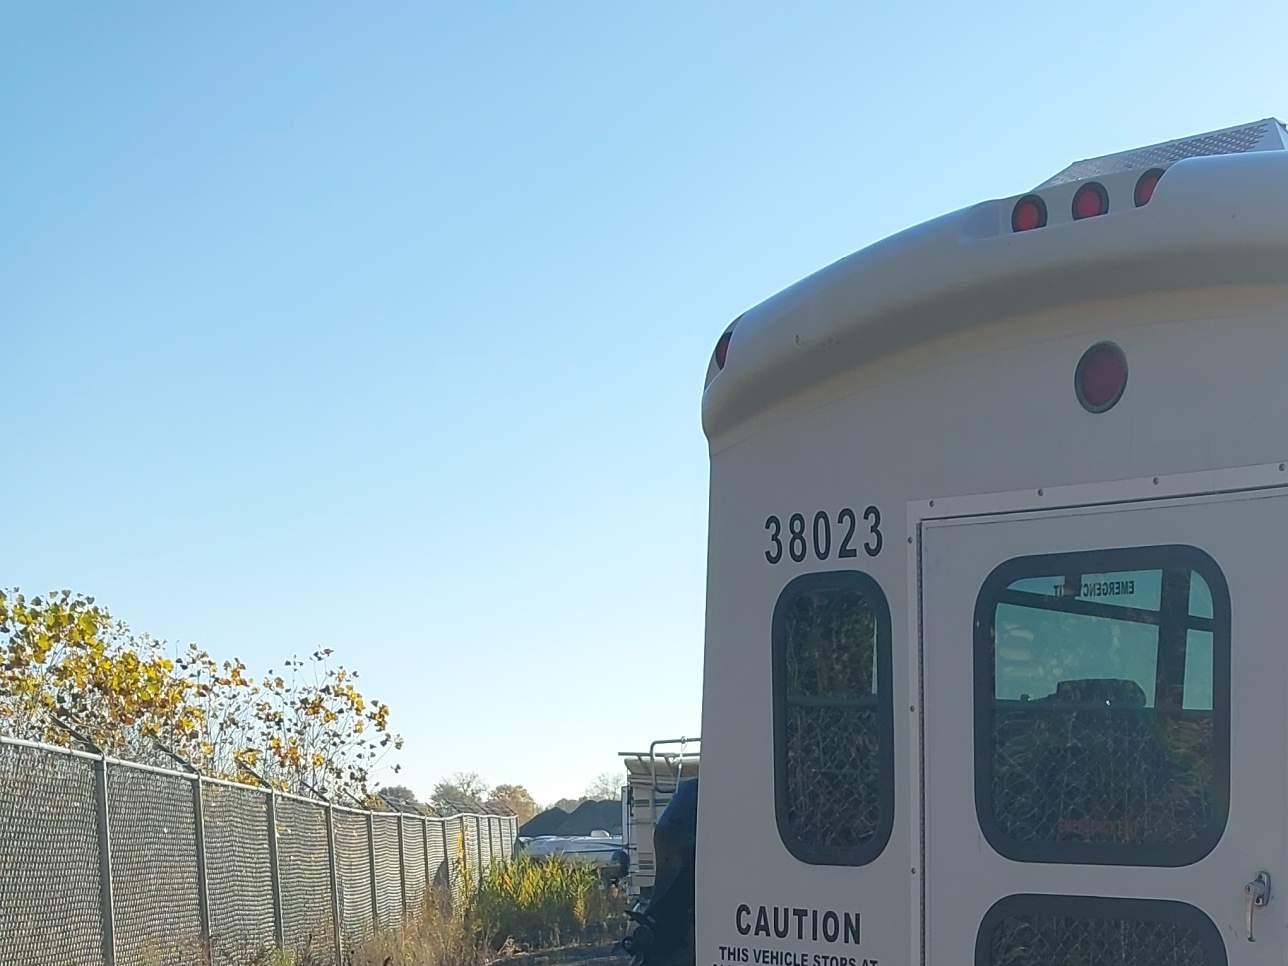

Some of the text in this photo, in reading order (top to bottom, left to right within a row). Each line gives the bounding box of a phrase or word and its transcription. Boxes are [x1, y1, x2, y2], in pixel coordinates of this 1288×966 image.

[764, 506, 883, 565] 38023
[736, 903, 861, 945] CAUTION
[719, 946, 748, 962] THIS
